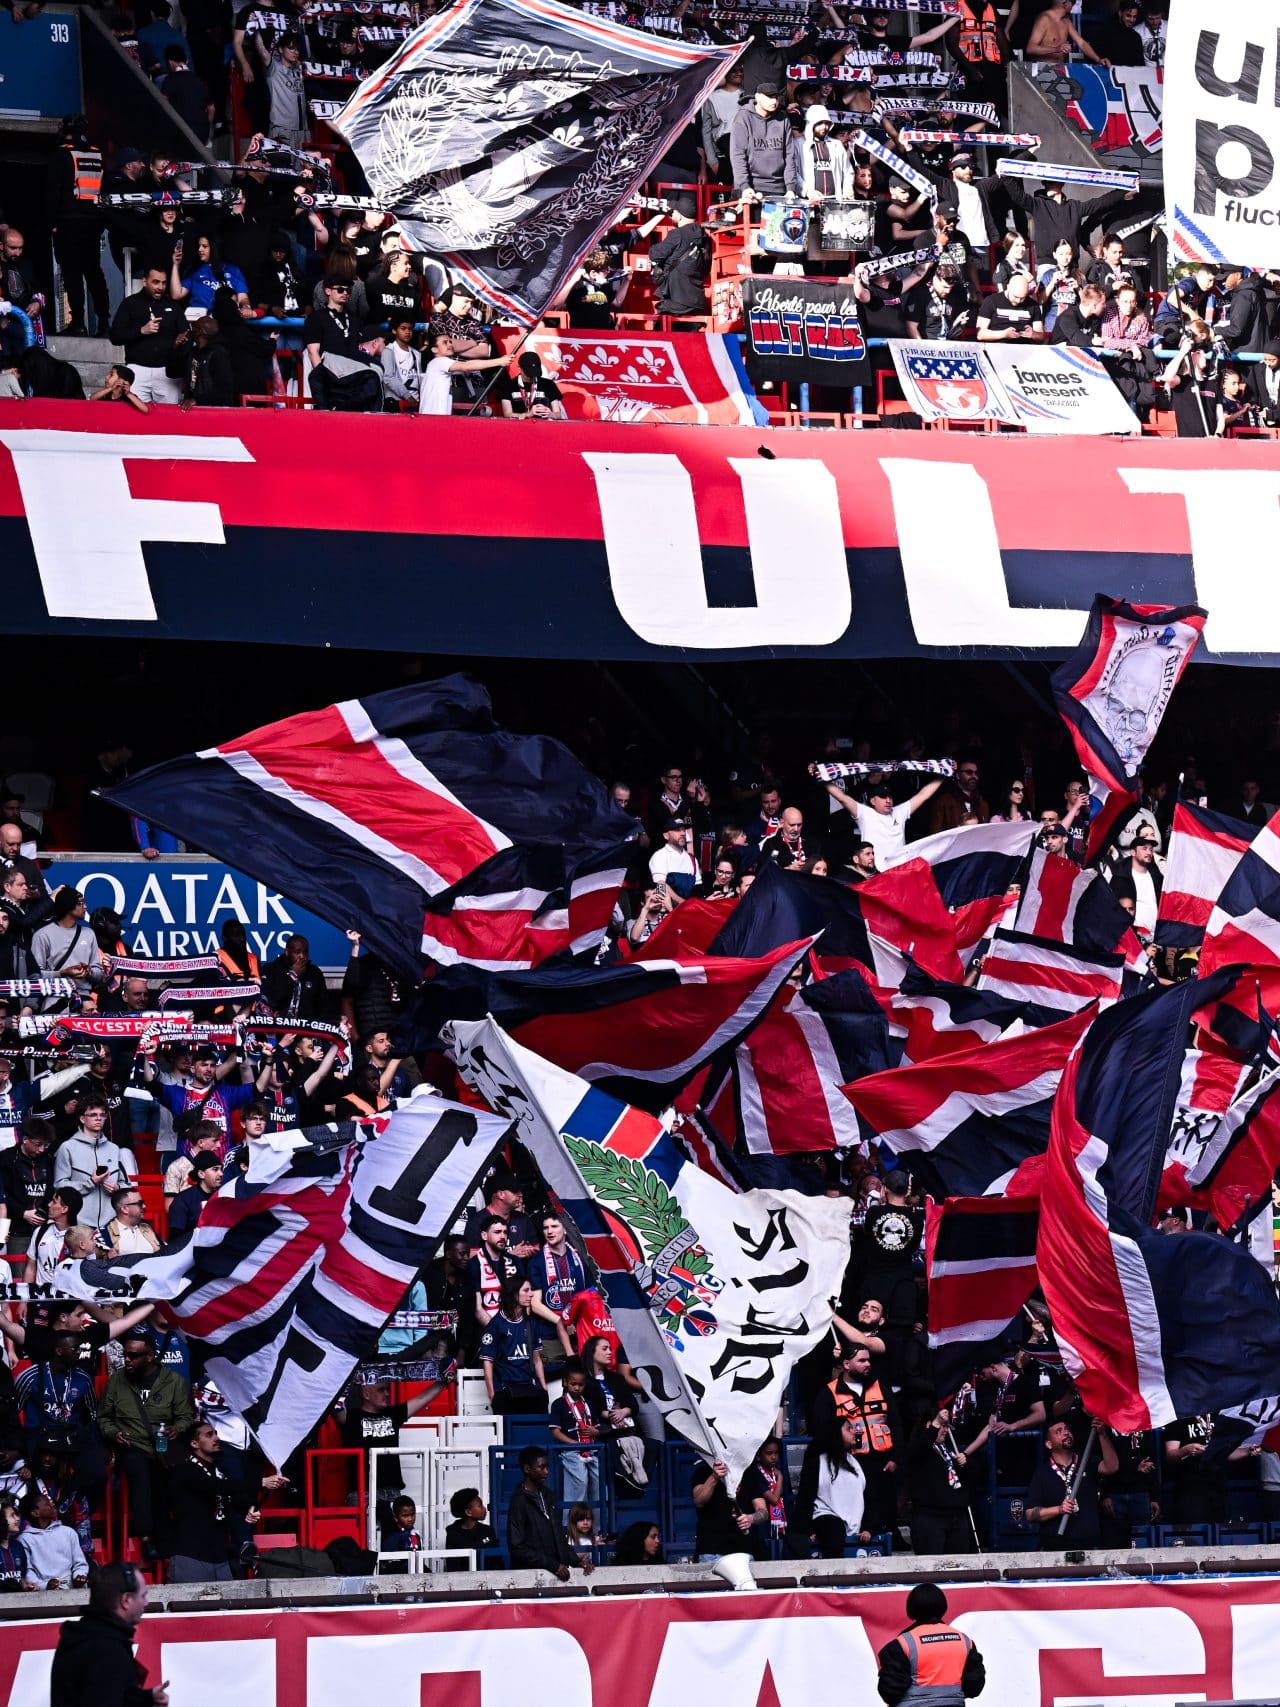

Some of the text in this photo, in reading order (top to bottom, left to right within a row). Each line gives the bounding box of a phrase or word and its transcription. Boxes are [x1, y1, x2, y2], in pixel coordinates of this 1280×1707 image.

[51, 24, 69, 43] 313
[876, 72, 950, 89] ARIS
[753, 137, 784, 151] PARIS
[752, 287, 804, 314] Liberté
[804, 301, 837, 318] pour
[749, 311, 866, 362] ULTRAS
[904, 348, 974, 360] VIRAGE AUTEUIL
[1013, 364, 1083, 386] james
[1022, 385, 1090, 400] present
[76, 873, 294, 924] QATAR
[131, 930, 294, 960] AIRWYS
[96, 1021, 131, 1032] C'EST
